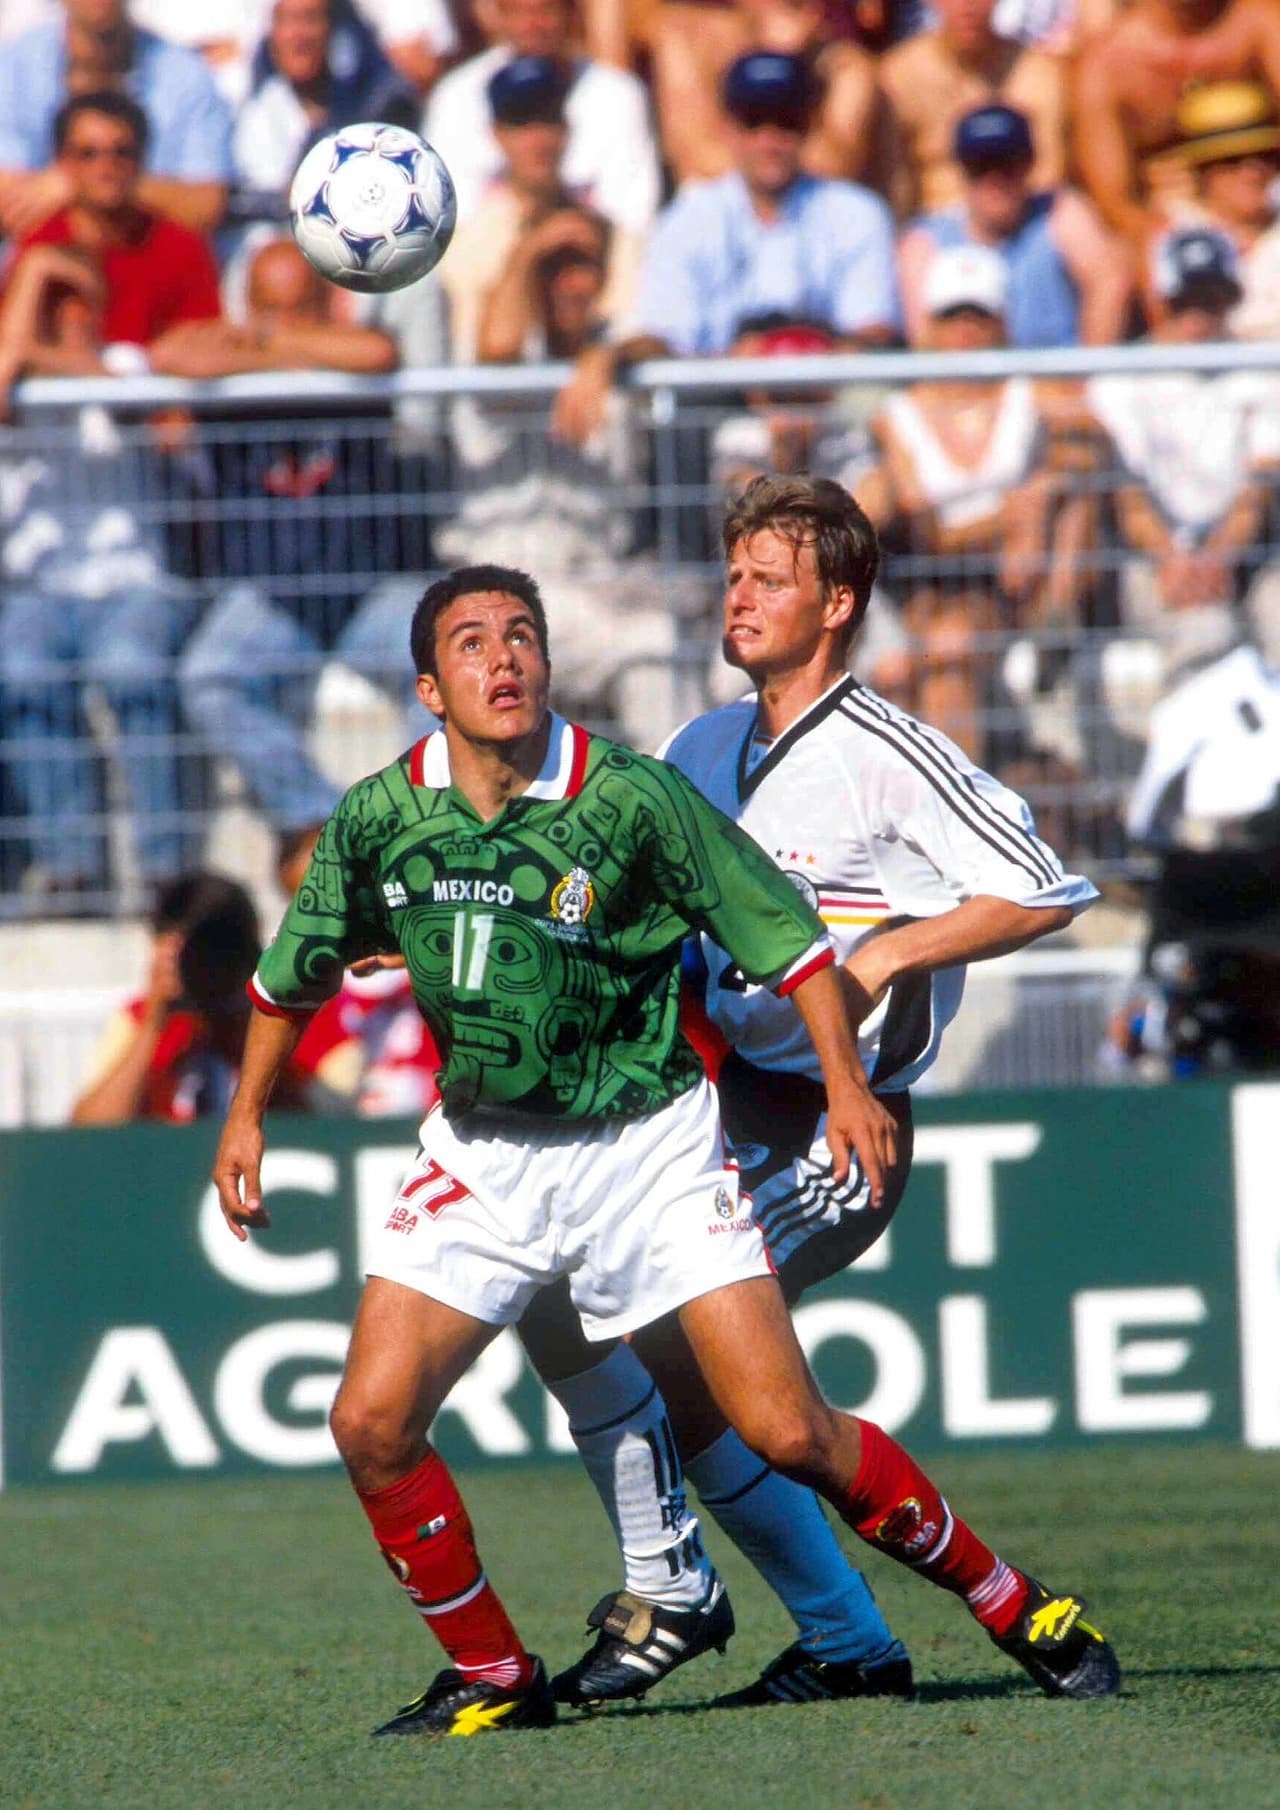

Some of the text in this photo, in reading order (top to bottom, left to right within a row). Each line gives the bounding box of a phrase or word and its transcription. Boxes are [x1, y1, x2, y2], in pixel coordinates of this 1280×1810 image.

[382, 881, 407, 897] BA
[432, 879, 515, 906] MEXICO
[708, 1218, 752, 1235] MEXICO
[50, 1285, 1213, 1475] AGROLE
